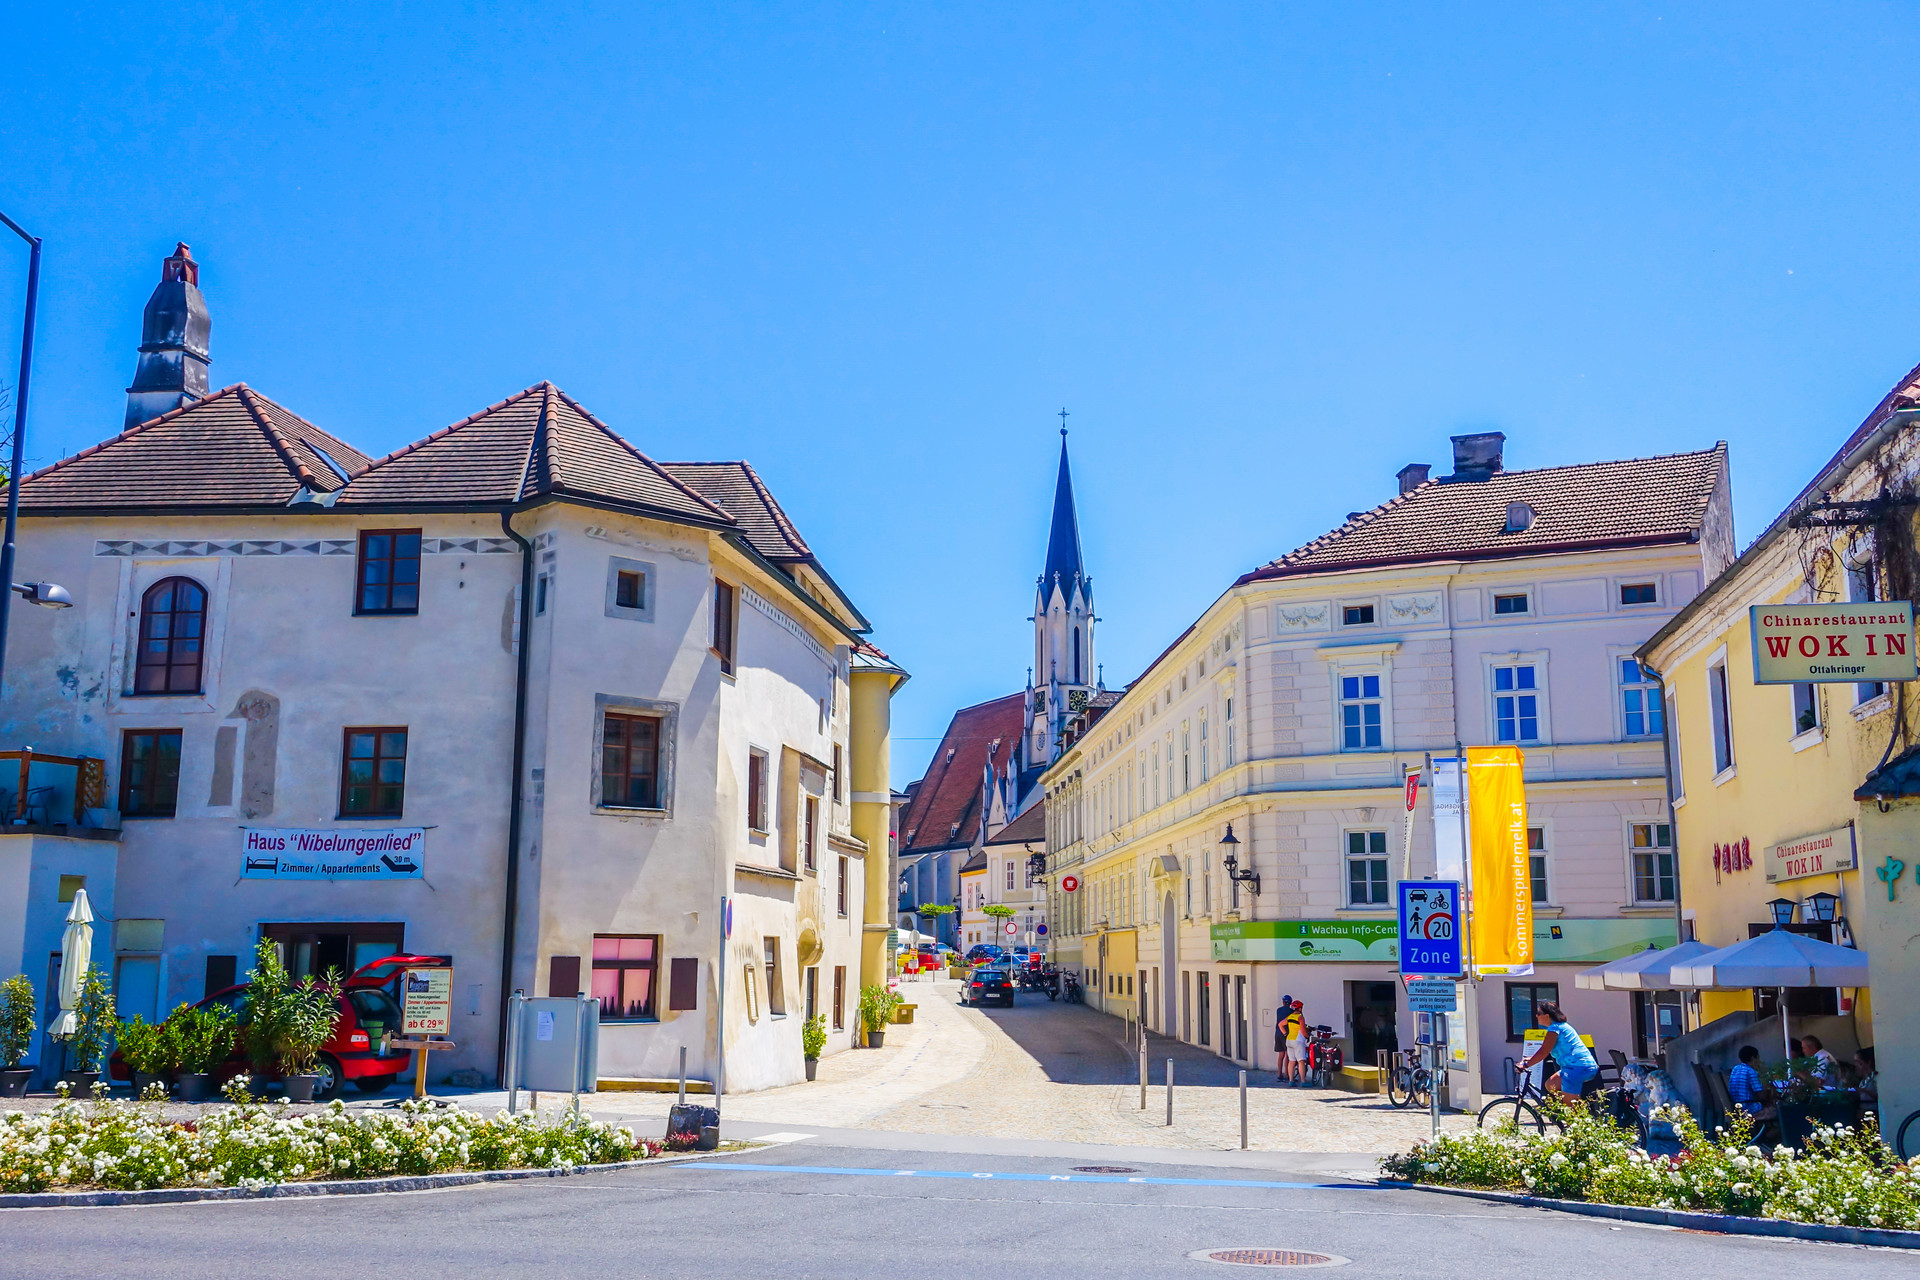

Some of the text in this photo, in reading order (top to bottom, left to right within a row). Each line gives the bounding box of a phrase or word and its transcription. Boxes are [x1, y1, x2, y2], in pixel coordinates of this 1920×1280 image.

[1763, 612, 1906, 627] Chinarestaurant
[1765, 633, 1907, 658] WOK IN
[1809, 665, 1866, 675] Ottakringer
[248, 833, 286, 851] Haus
[1777, 835, 1833, 859] Chinarestaurant
[281, 863, 314, 873] Zimmer
[321, 863, 381, 875] Appartements
[1786, 855, 1823, 877] WOK IN
[1510, 802, 1529, 957] sommerspielemelk.at
[1311, 925, 1398, 936] Wachau Info-Cent
[1433, 921, 1451, 938] 20
[1410, 948, 1451, 964] Zone
[408, 1019, 418, 1028] ab
[420, 1019, 425, 1028] €
[427, 1019, 437, 1028] 29
